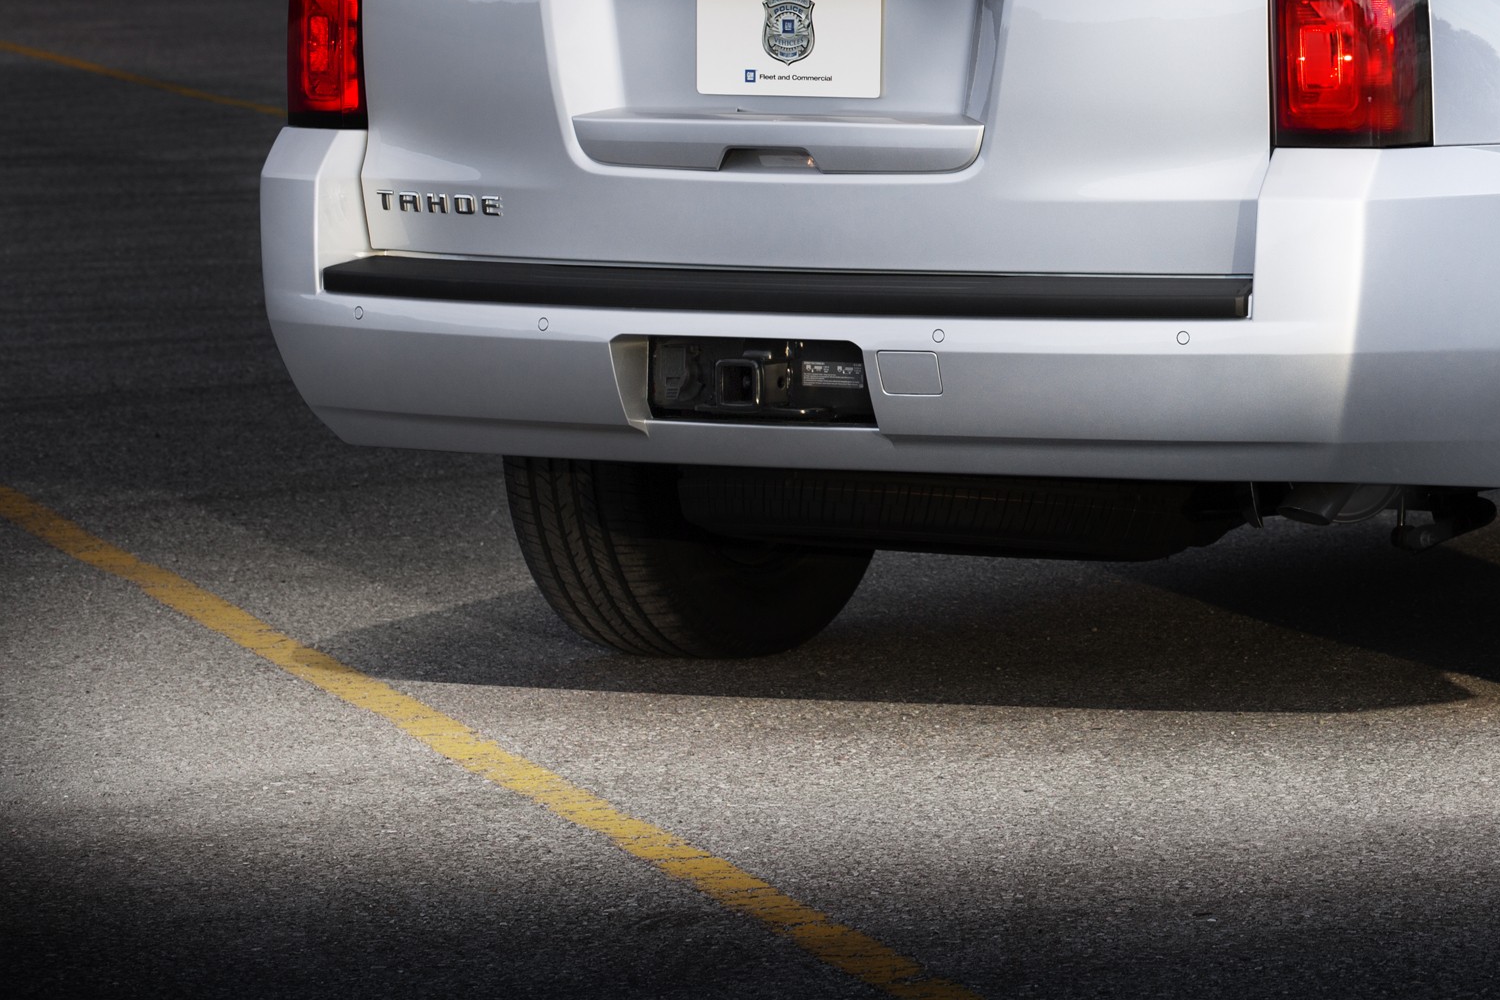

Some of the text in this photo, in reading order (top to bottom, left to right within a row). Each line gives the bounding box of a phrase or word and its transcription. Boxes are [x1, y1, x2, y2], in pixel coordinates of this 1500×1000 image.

[774, 5, 804, 15] POLICE
[759, 73, 776, 81] Fleet
[791, 74, 833, 82] Commercial
[376, 189, 503, 216] TAHOE
